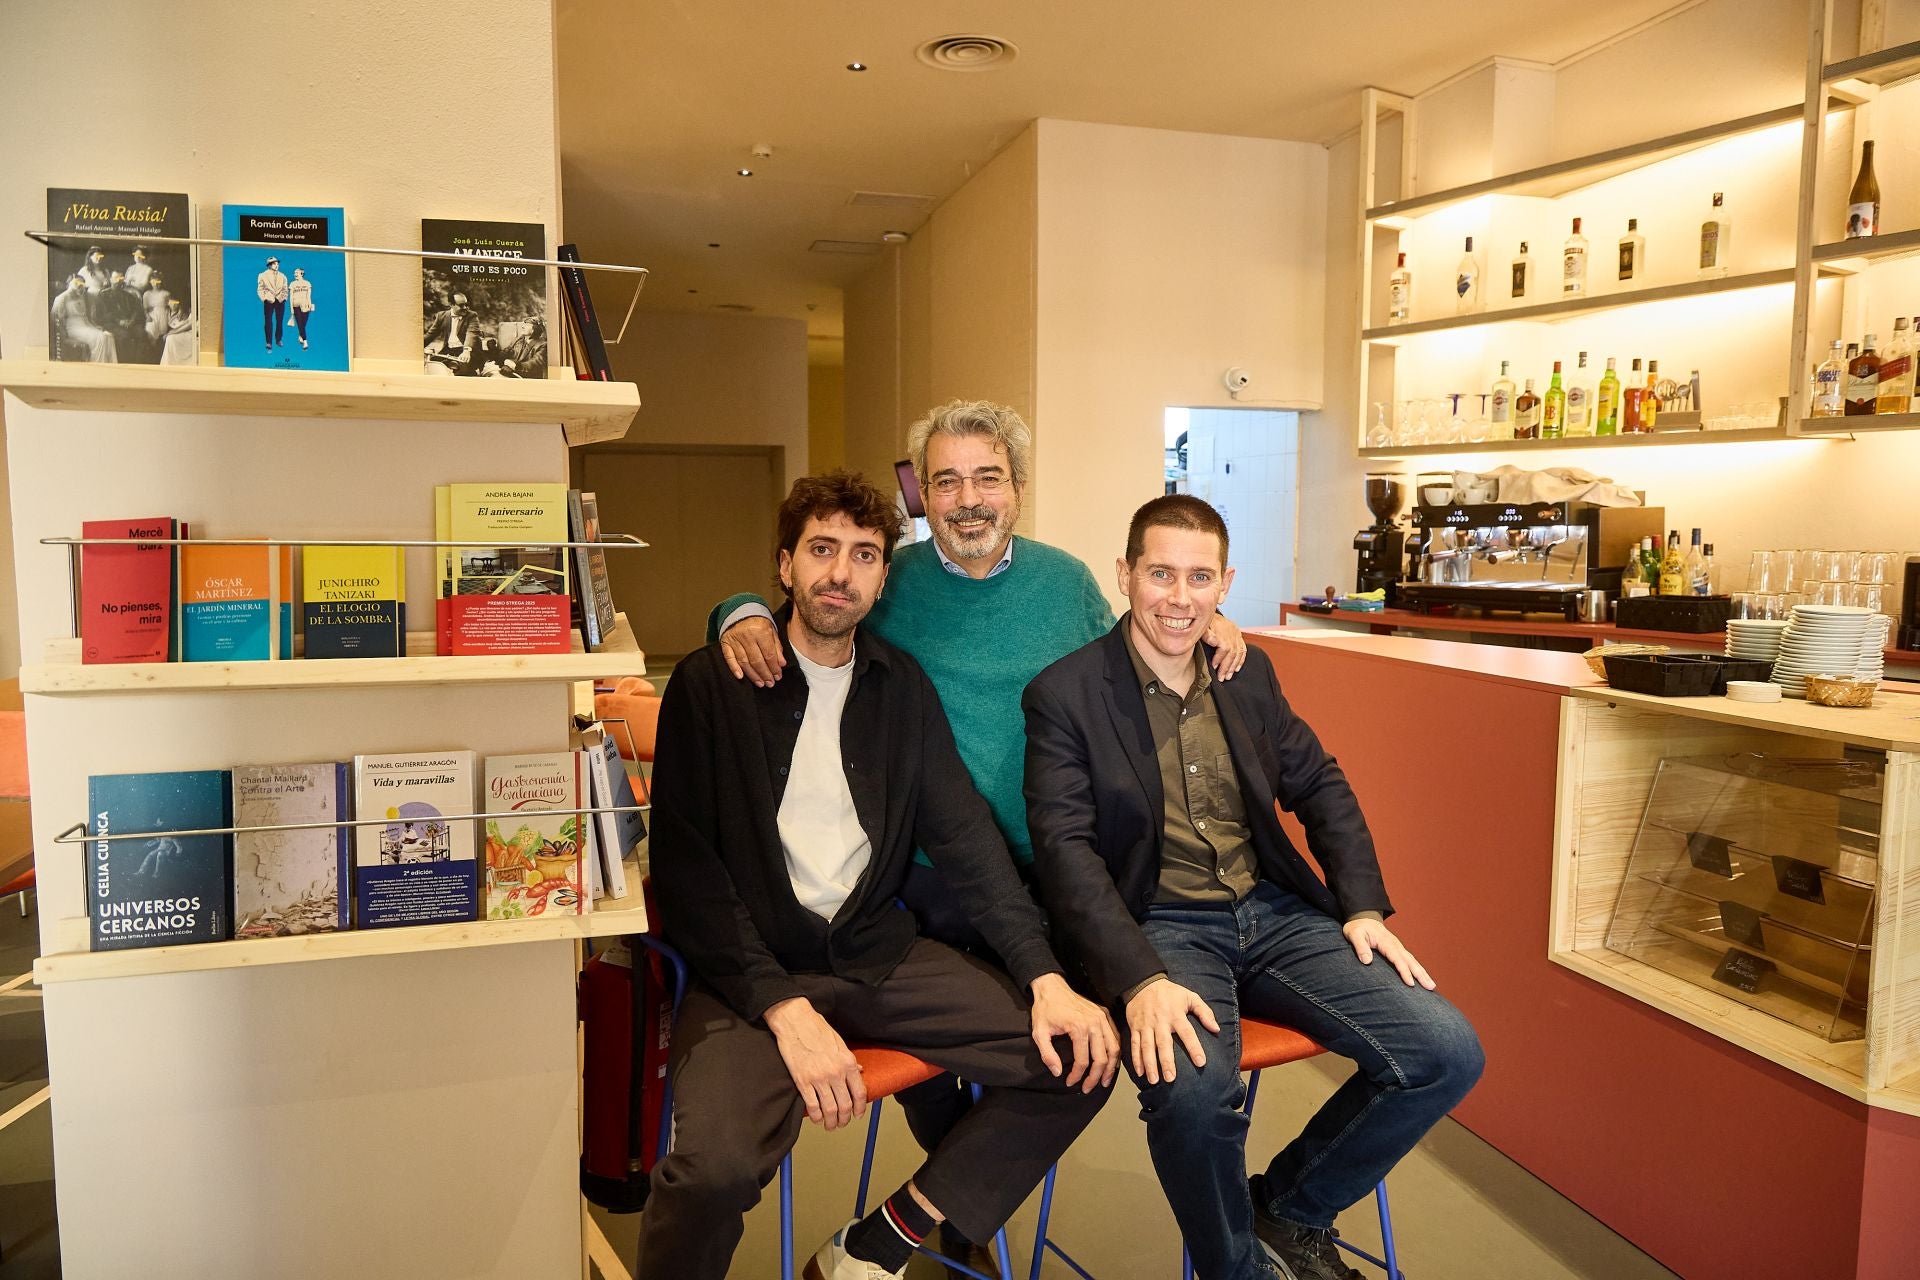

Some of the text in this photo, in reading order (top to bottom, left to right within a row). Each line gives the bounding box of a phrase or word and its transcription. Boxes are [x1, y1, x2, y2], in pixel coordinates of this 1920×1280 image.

[64, 203, 168, 223] ¡Viva Rusia!
[250, 219, 318, 230] Román Gubern
[495, 239, 524, 247] Cuerda
[452, 265, 527, 275] QUE NO ES POCO
[477, 507, 544, 516] El aniversario
[128, 526, 163, 538] Mercè
[205, 577, 242, 588] ÓSCAR
[196, 588, 253, 599] MARTÍNEZ
[324, 590, 375, 599] TANIZAKI
[101, 602, 162, 615] No pienses,
[197, 604, 225, 614] JARDÍN
[227, 603, 263, 611] MINERAL
[320, 603, 380, 612] EL ELOGIO
[139, 613, 162, 624] mira
[309, 615, 392, 625] DE LA SOMBRA
[428, 759, 457, 767] ARAGÓN
[240, 775, 307, 784] Chantal Maillard
[373, 775, 455, 788] Vida y maravillas
[240, 785, 305, 795] Contra el Arte
[98, 863, 109, 898] CELIA
[100, 896, 201, 917] UNIVERSOS
[100, 913, 196, 934] CERCANOS
